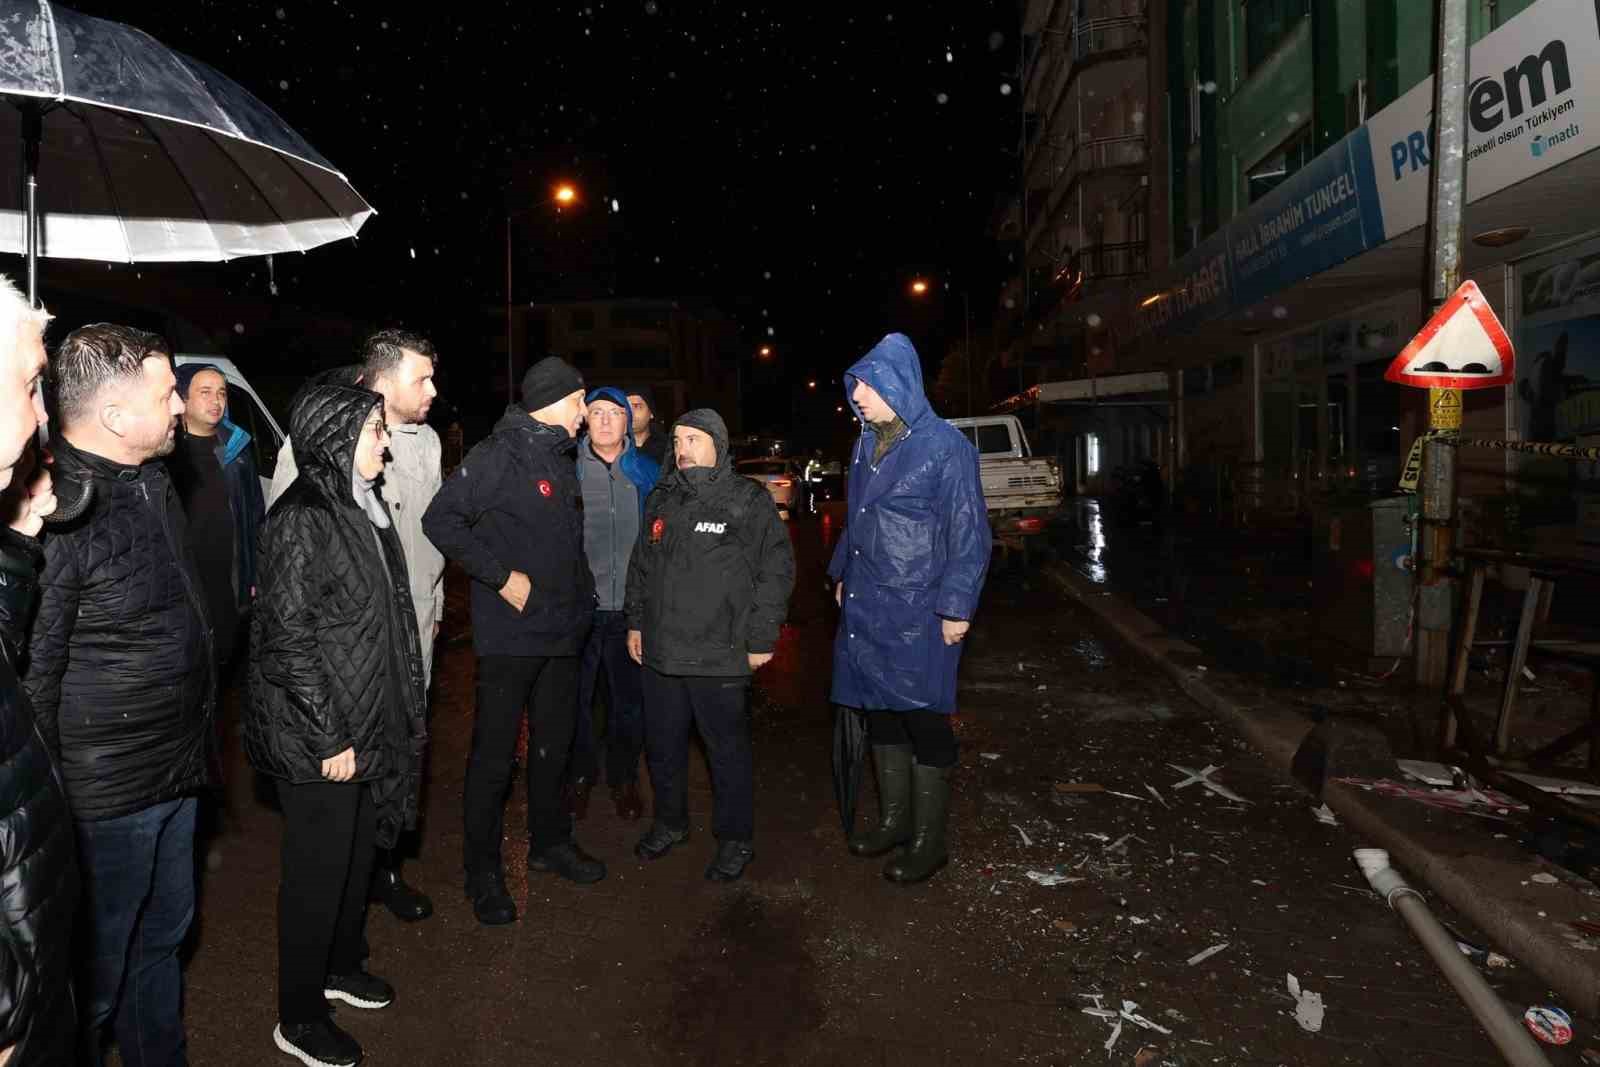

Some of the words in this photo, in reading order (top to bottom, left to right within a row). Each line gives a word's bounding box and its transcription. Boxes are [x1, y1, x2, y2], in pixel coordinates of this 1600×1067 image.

[1466, 136, 1496, 162] ereketli
[1498, 126, 1524, 145] olsun
[1525, 98, 1575, 130] Türkiyem
[694, 521, 727, 534] AFAD
